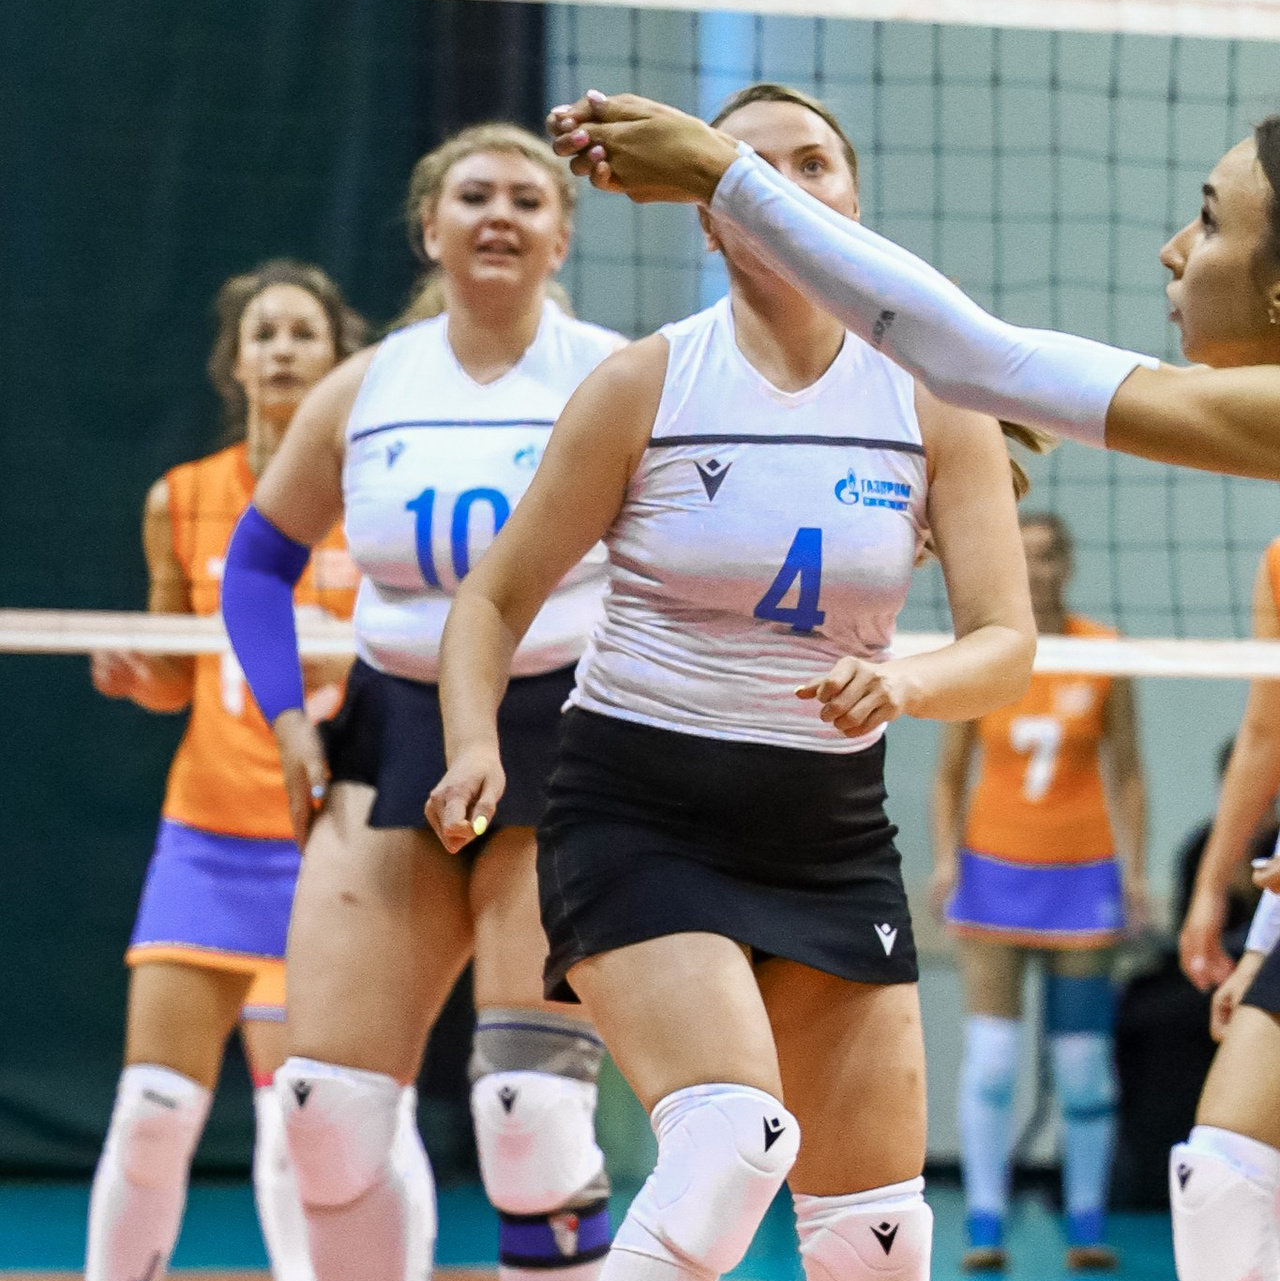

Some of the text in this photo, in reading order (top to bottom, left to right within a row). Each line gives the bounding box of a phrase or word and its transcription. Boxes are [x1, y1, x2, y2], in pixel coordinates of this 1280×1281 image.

[406, 486, 510, 589] 10
[753, 527, 826, 635] 4
[1010, 716, 1064, 802] 7
